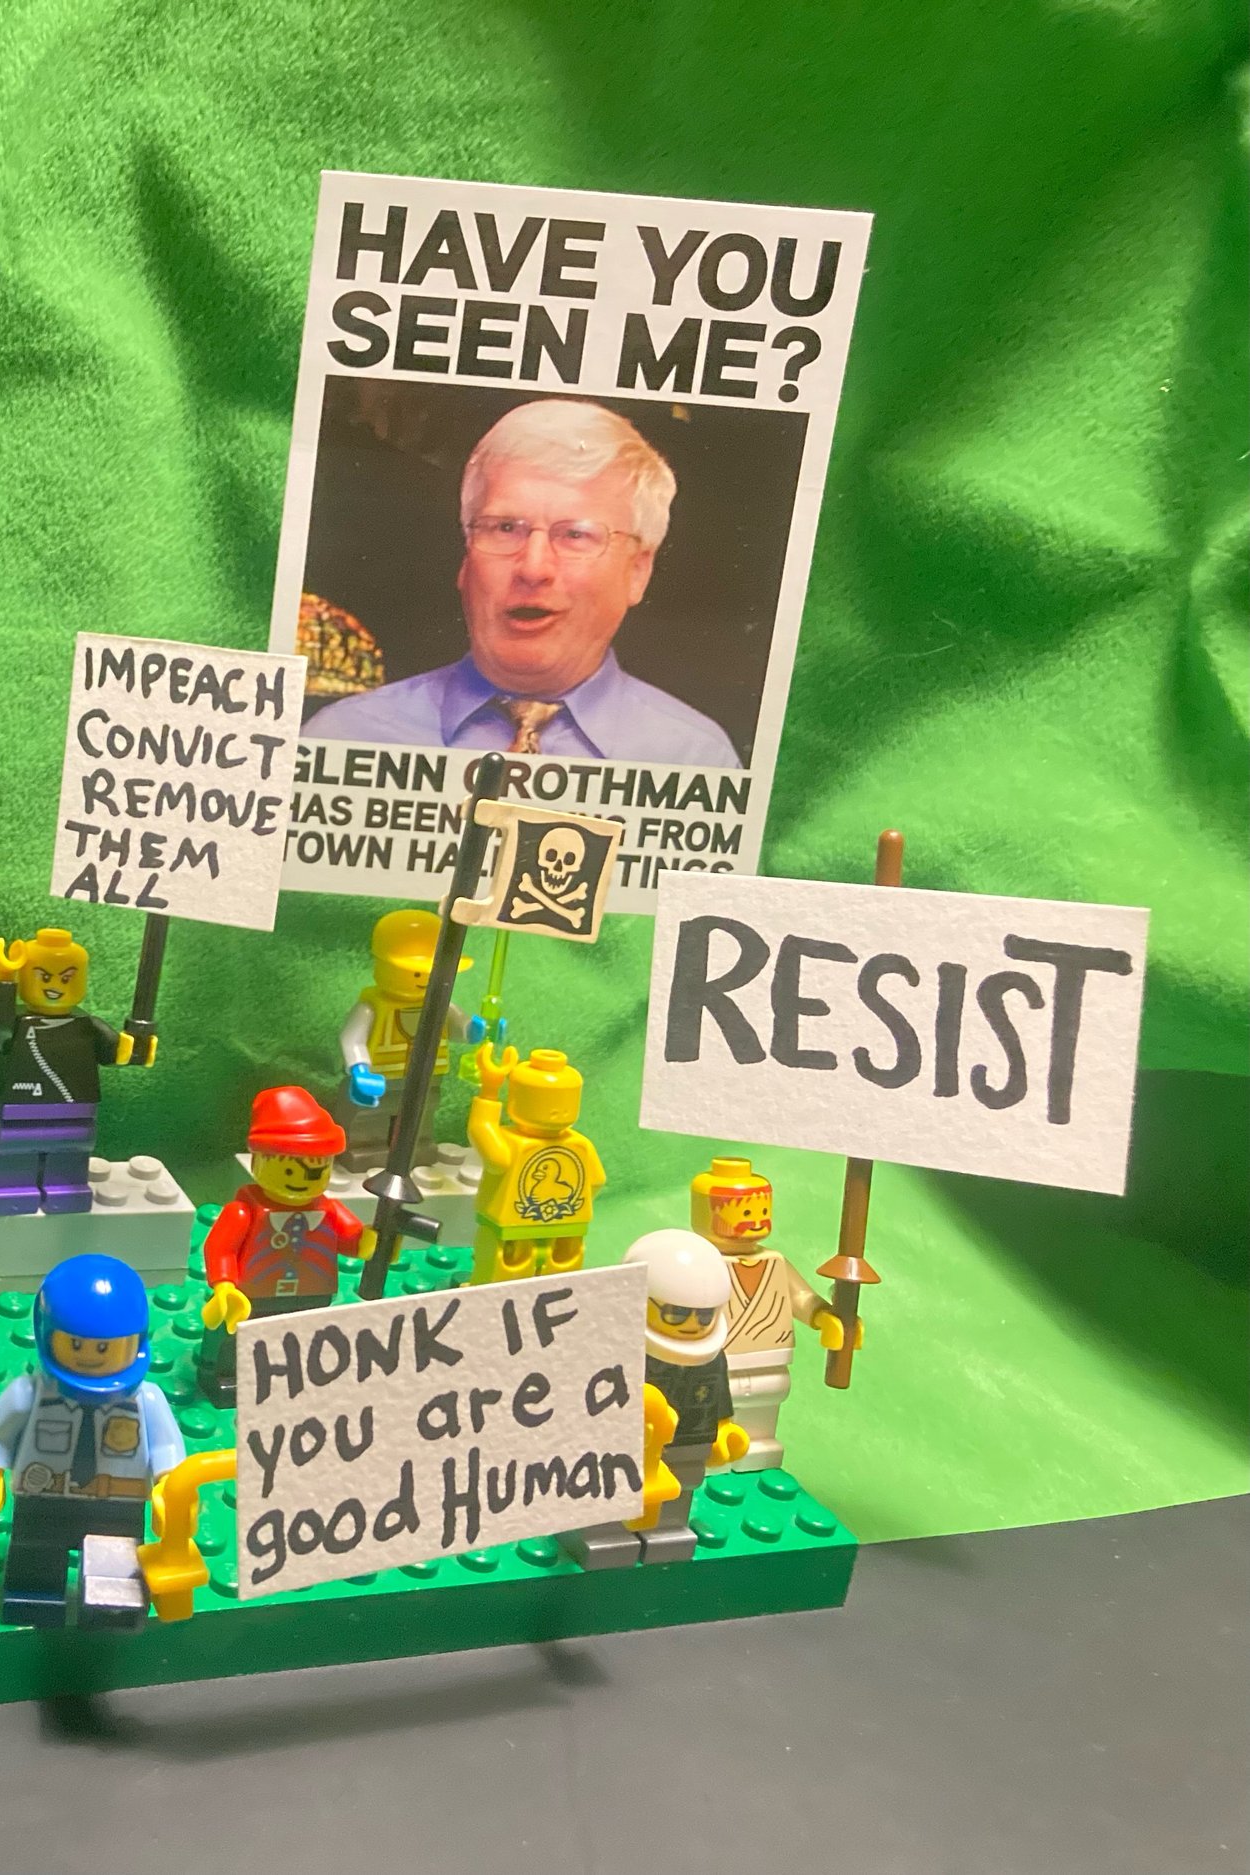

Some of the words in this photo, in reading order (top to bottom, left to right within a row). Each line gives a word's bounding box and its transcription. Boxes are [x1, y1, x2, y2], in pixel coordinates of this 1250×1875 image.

[336, 202, 606, 299] HAVE
[637, 226, 843, 317] YOU
[326, 291, 588, 384] SEEN
[617, 313, 822, 402] ME?
[85, 647, 285, 720] IMPEACH
[77, 708, 286, 780] CONVICT
[82, 768, 282, 836] REMOVE
[364, 797, 462, 834] BEEN
[638, 817, 743, 854] FROM
[64, 862, 168, 909] ALL
[65, 820, 219, 879] THEM
[664, 915, 1133, 1125] RESIST
[253, 1299, 463, 1404] HONK
[502, 1287, 578, 1356] IF
[417, 1372, 554, 1441] are
[585, 1364, 630, 1416] a
[246, 1460, 420, 1585] good
[441, 1447, 643, 1548] Human
